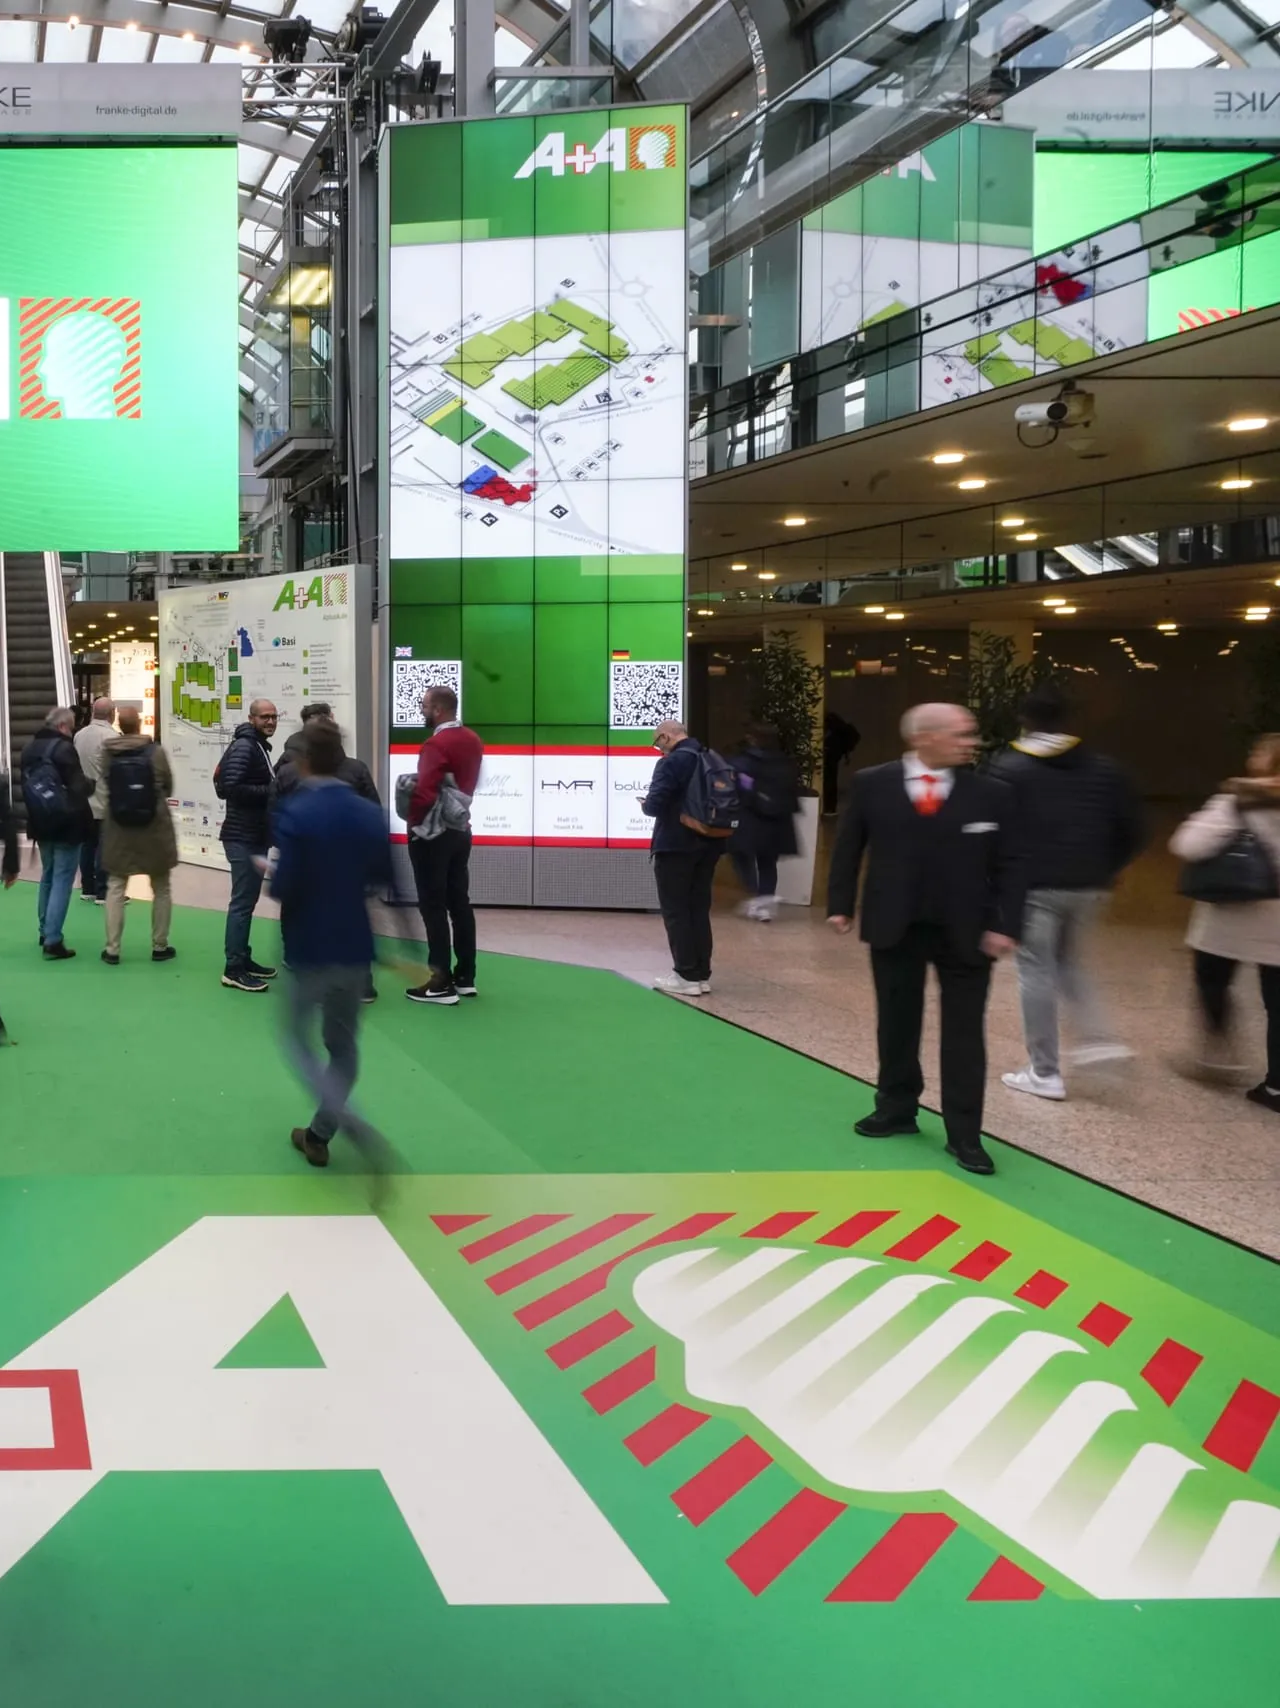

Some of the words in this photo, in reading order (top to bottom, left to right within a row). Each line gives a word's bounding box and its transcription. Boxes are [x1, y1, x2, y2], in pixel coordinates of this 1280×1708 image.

[95, 104, 178, 118] franke-digital.de
[513, 127, 627, 179] A+A
[272, 576, 323, 612] A+A
[281, 637, 296, 647] Basi
[541, 779, 594, 791] HMR
